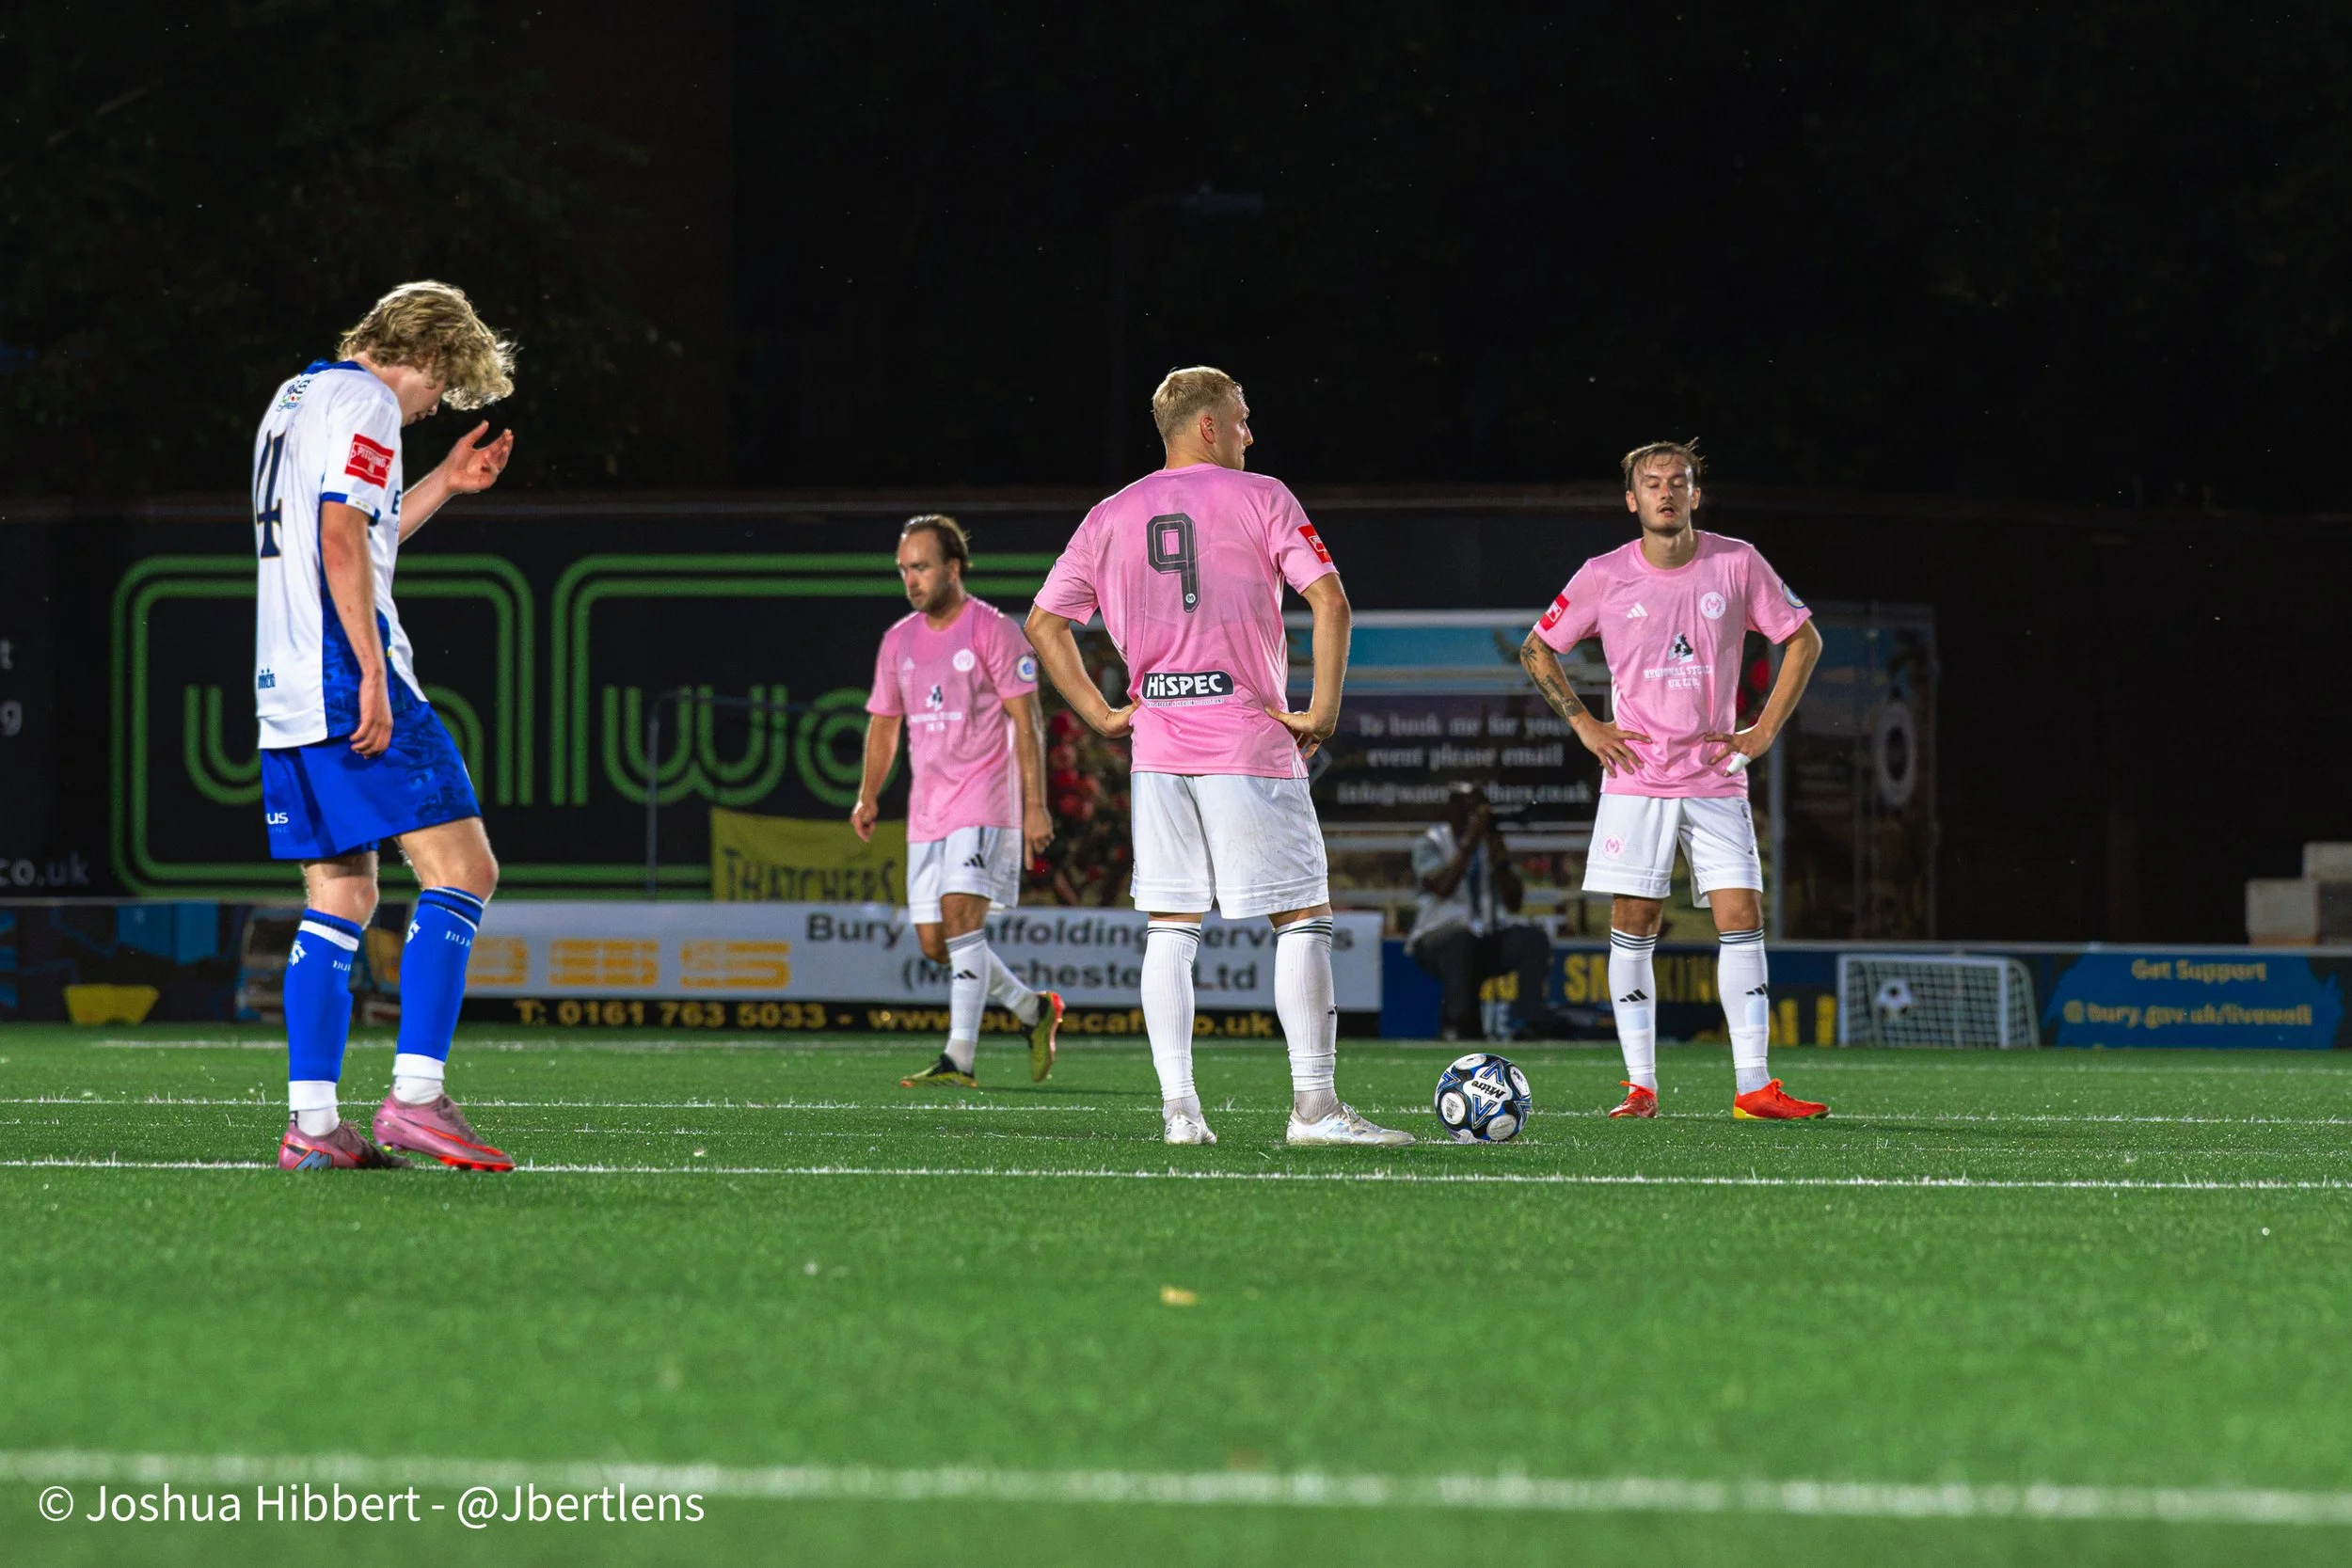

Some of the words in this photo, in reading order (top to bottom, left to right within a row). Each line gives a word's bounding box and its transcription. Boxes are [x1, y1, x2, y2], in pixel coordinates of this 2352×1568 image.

[1147, 513, 1200, 613] 9
[1360, 713, 1384, 736] To
[1388, 712, 1442, 736] book
[1449, 717, 1483, 736] me
[1487, 713, 1518, 736] for
[1366, 746, 1423, 768] event
[1428, 742, 1498, 771] please
[1501, 742, 1564, 768] email
[723, 847, 898, 903] THATCHERS
[806, 912, 903, 950] Bury
[1192, 961, 1258, 990] Ltd
[2131, 958, 2171, 980] Get
[2176, 959, 2266, 984] Support
[515, 1000, 546, 1025] T:
[558, 1001, 645, 1025] 0161
[660, 1002, 725, 1027] 763
[737, 1003, 826, 1029] 5033
